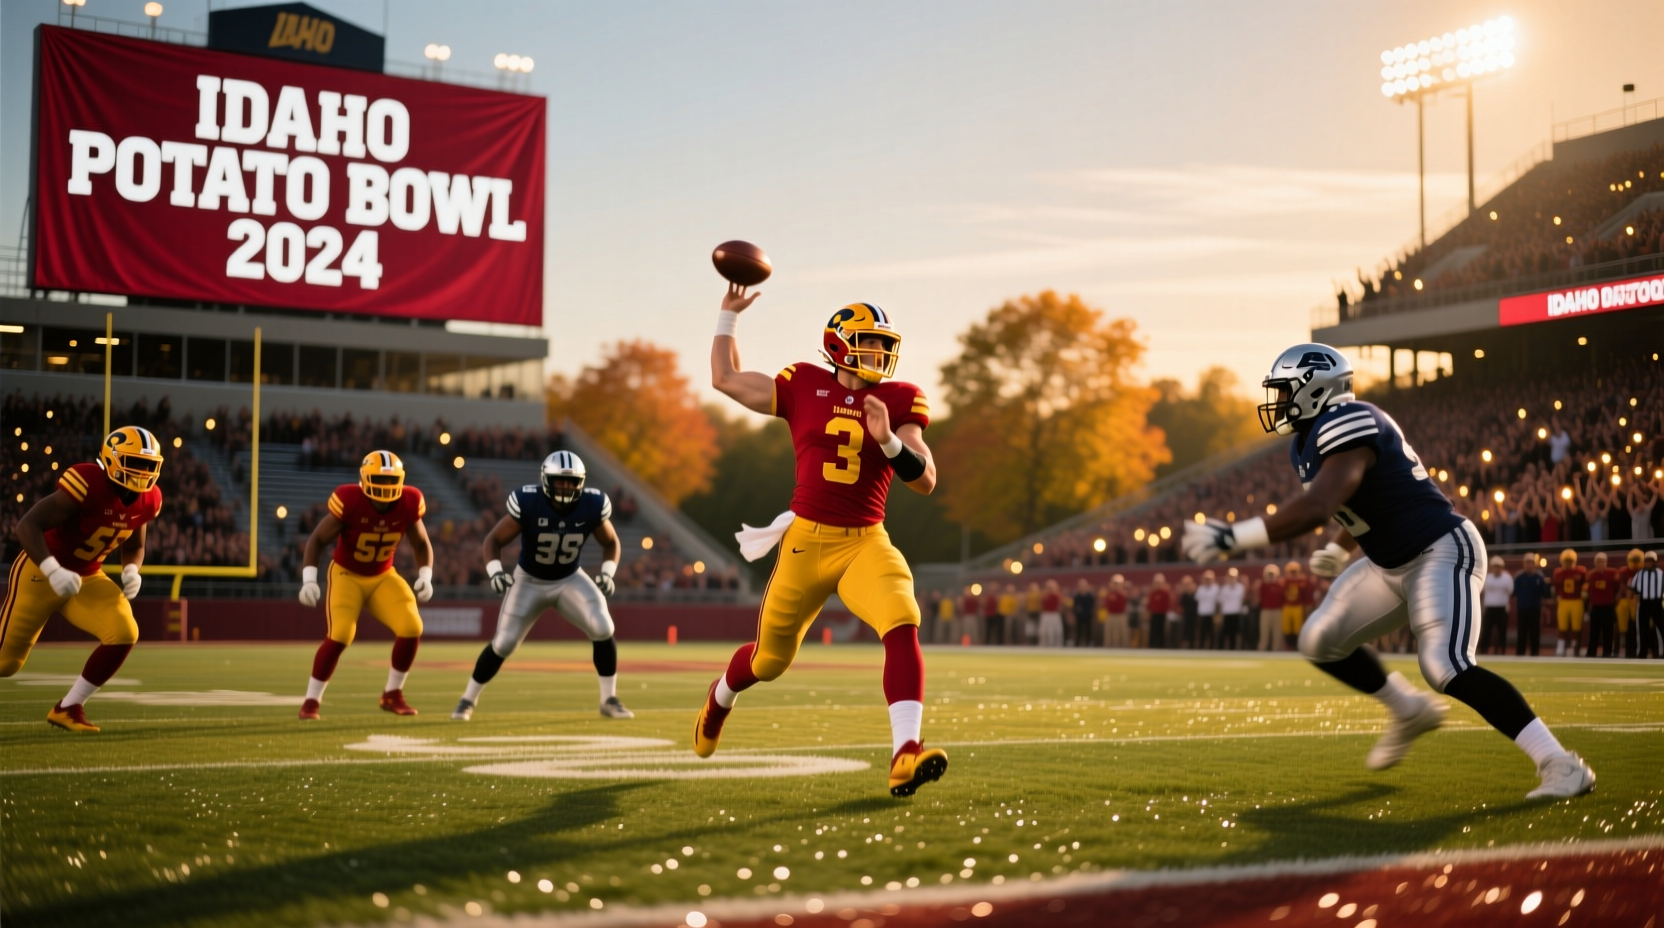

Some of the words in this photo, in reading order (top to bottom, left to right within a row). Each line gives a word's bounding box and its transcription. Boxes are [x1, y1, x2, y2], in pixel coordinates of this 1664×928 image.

[194, 74, 411, 163] IDAHO
[67, 129, 331, 221] POTATO
[345, 161, 527, 243] BOWL
[225, 217, 384, 290] 2024
[1547, 288, 1600, 317] IDAHO
[823, 418, 864, 485] 3
[353, 532, 402, 563] 52
